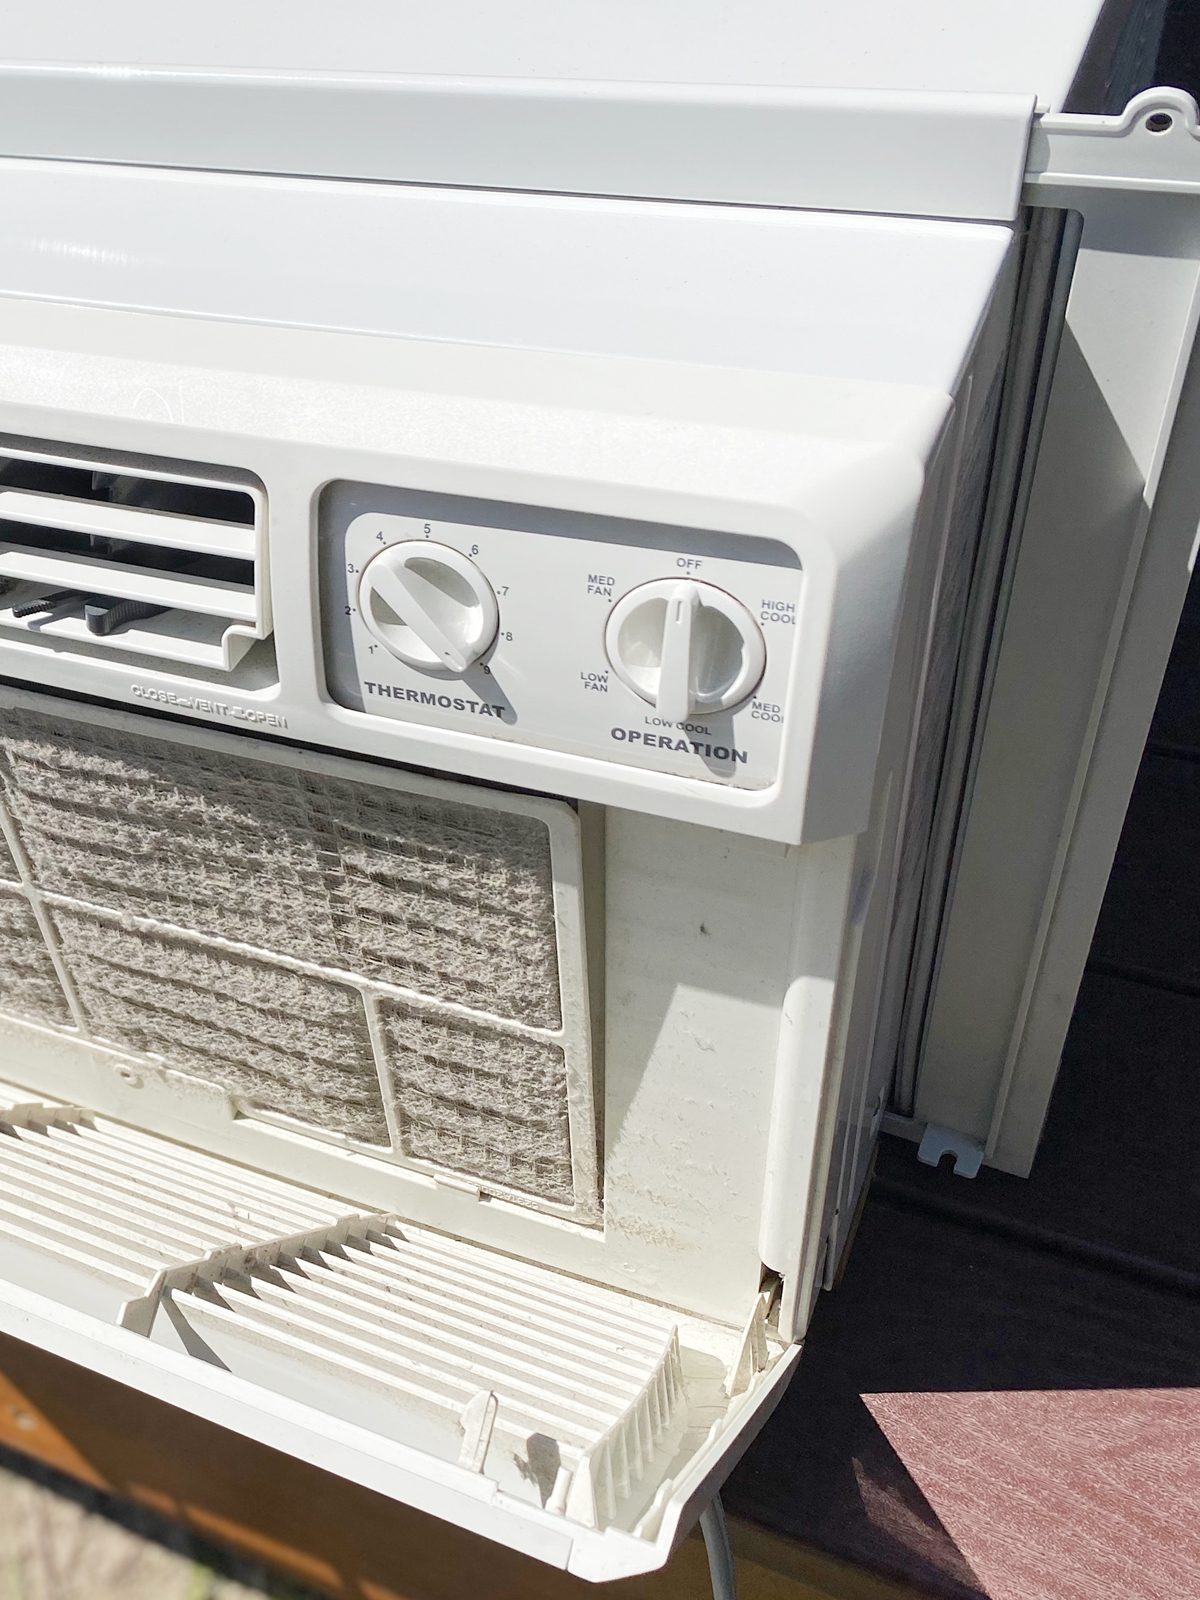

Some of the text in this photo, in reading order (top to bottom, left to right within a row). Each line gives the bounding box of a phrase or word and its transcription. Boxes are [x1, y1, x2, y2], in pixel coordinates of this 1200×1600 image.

[424, 524, 431, 534] 5
[376, 531, 383, 541] 4
[471, 545, 479, 555] 6
[347, 564, 354, 573] 3
[676, 558, 703, 569] OFF
[588, 574, 615, 586] MED
[502, 586, 509, 596] 7
[587, 585, 612, 597] FAN
[345, 606, 351, 615] 2
[761, 600, 795, 612] HIGH
[505, 632, 513, 641] 8
[368, 645, 374, 654] 1
[483, 665, 491, 675] 9
[580, 671, 609, 683] LOW
[584, 681, 608, 693] FAN
[131, 684, 287, 728] CLOSE VENT OPEN
[364, 682, 505, 718] THERMOSTAT
[751, 701, 780, 713] MED
[645, 716, 673, 728] LOW
[751, 711, 783, 723] COO
[611, 727, 747, 764] OPERATION
